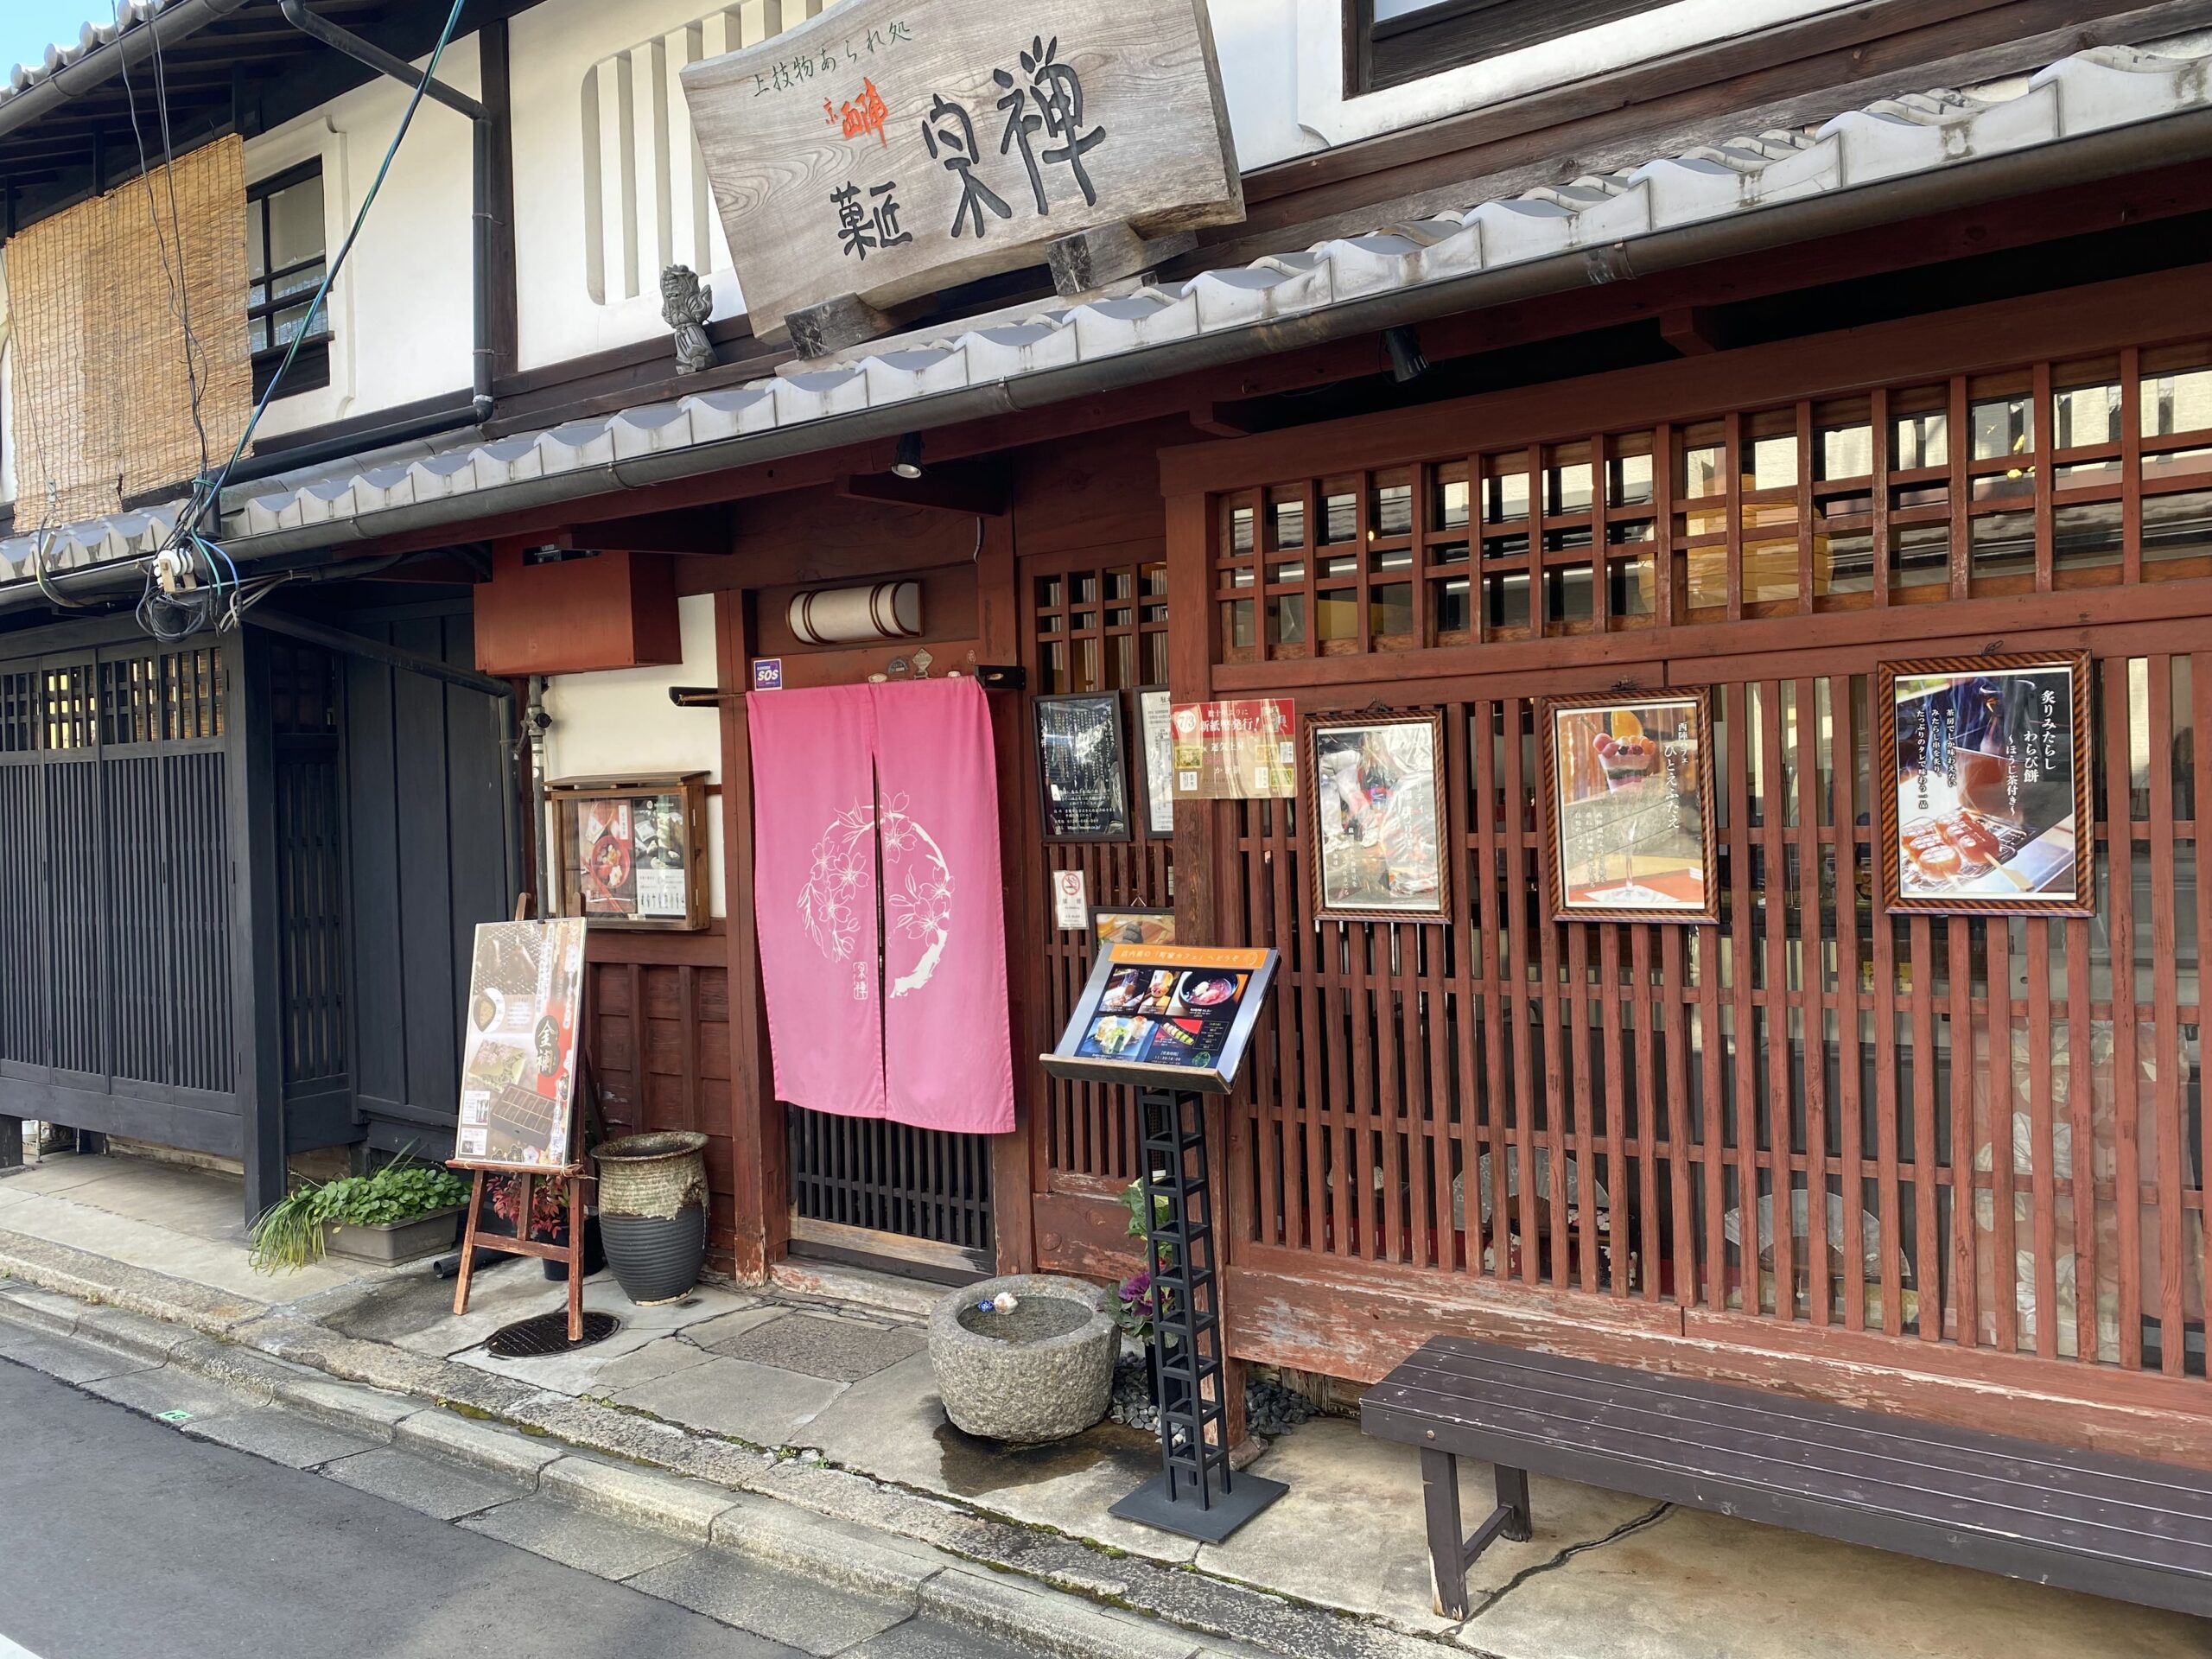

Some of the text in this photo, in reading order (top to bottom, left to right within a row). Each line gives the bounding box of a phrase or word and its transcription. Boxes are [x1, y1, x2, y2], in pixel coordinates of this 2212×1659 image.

[830, 180, 912, 261] 菓匠
[758, 669, 779, 681] SOS
[1946, 709, 1957, 787] 茶房でしか味わえない
[2024, 730, 2039, 783] わらび餅
[2040, 690, 2056, 770] 炙りみたらし
[1664, 745, 1680, 828] ひとえふたえ
